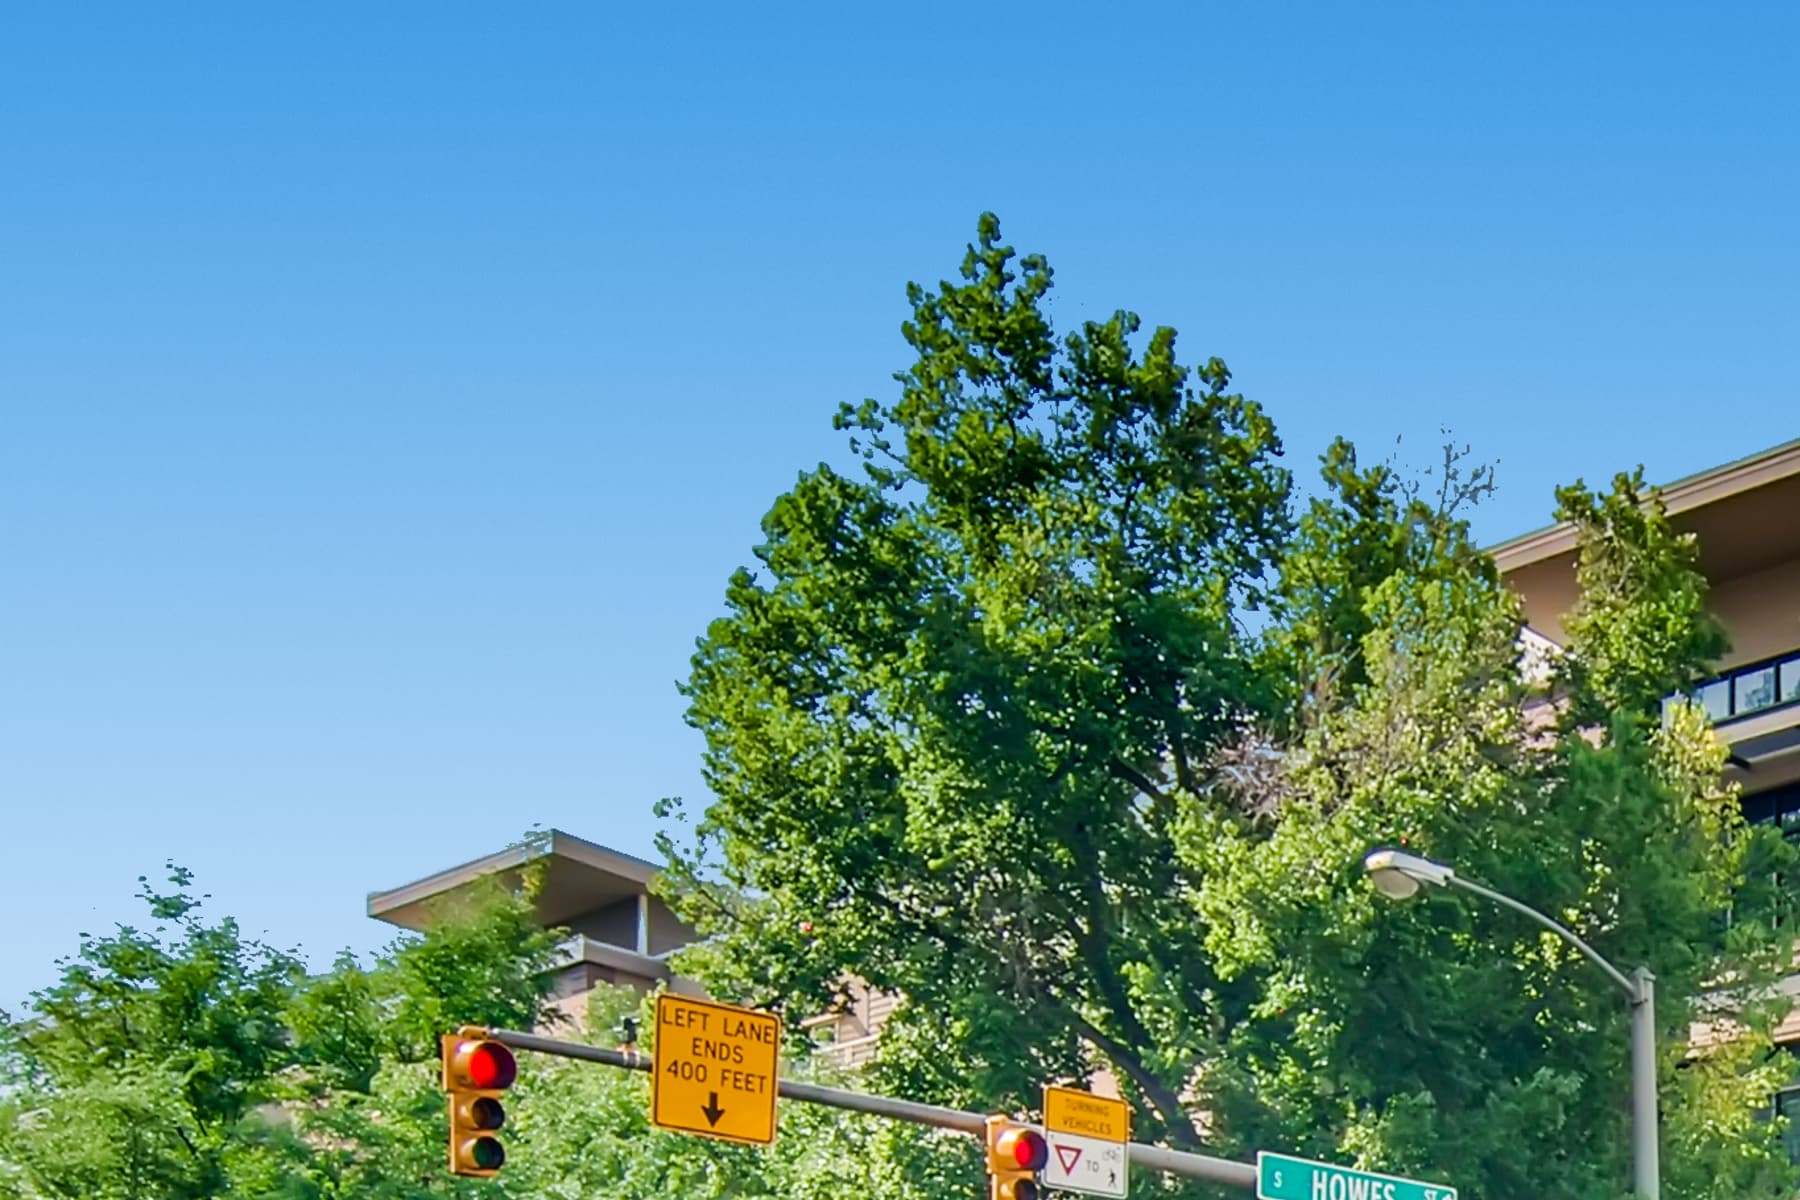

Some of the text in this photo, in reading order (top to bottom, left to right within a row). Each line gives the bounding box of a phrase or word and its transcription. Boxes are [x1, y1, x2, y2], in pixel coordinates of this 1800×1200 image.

[662, 1005, 775, 1045] LEFT LANE
[692, 1037, 744, 1064] ENDS
[666, 1059, 767, 1094] 400 FEET
[1062, 1117, 1113, 1136] VEHICLES
[1086, 1159, 1100, 1173] TO
[1272, 1171, 1283, 1188] S
